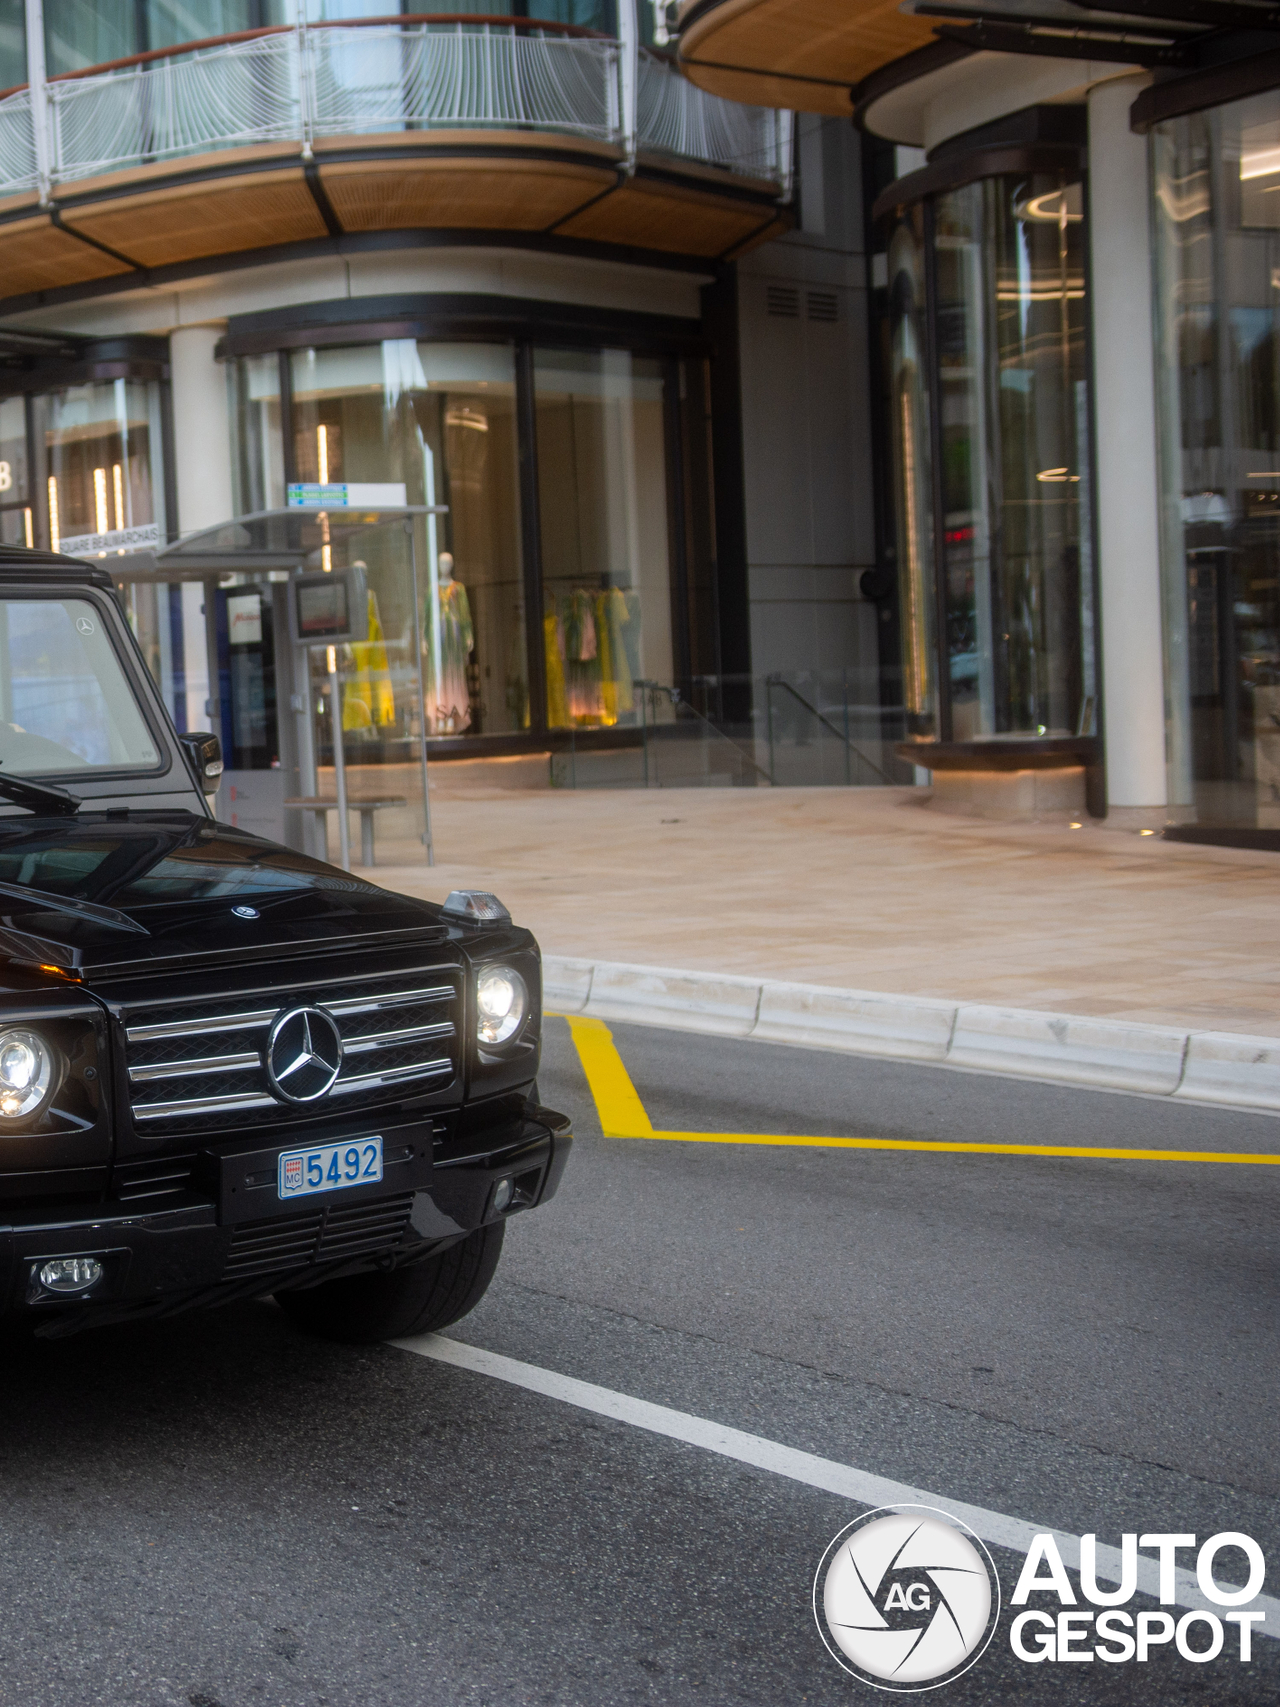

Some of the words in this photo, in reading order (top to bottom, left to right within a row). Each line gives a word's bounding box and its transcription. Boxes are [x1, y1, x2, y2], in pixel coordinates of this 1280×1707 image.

[92, 527, 158, 550] BEAUMARCHAIS
[286, 1172, 301, 1184] MC
[307, 1144, 378, 1188] 5492
